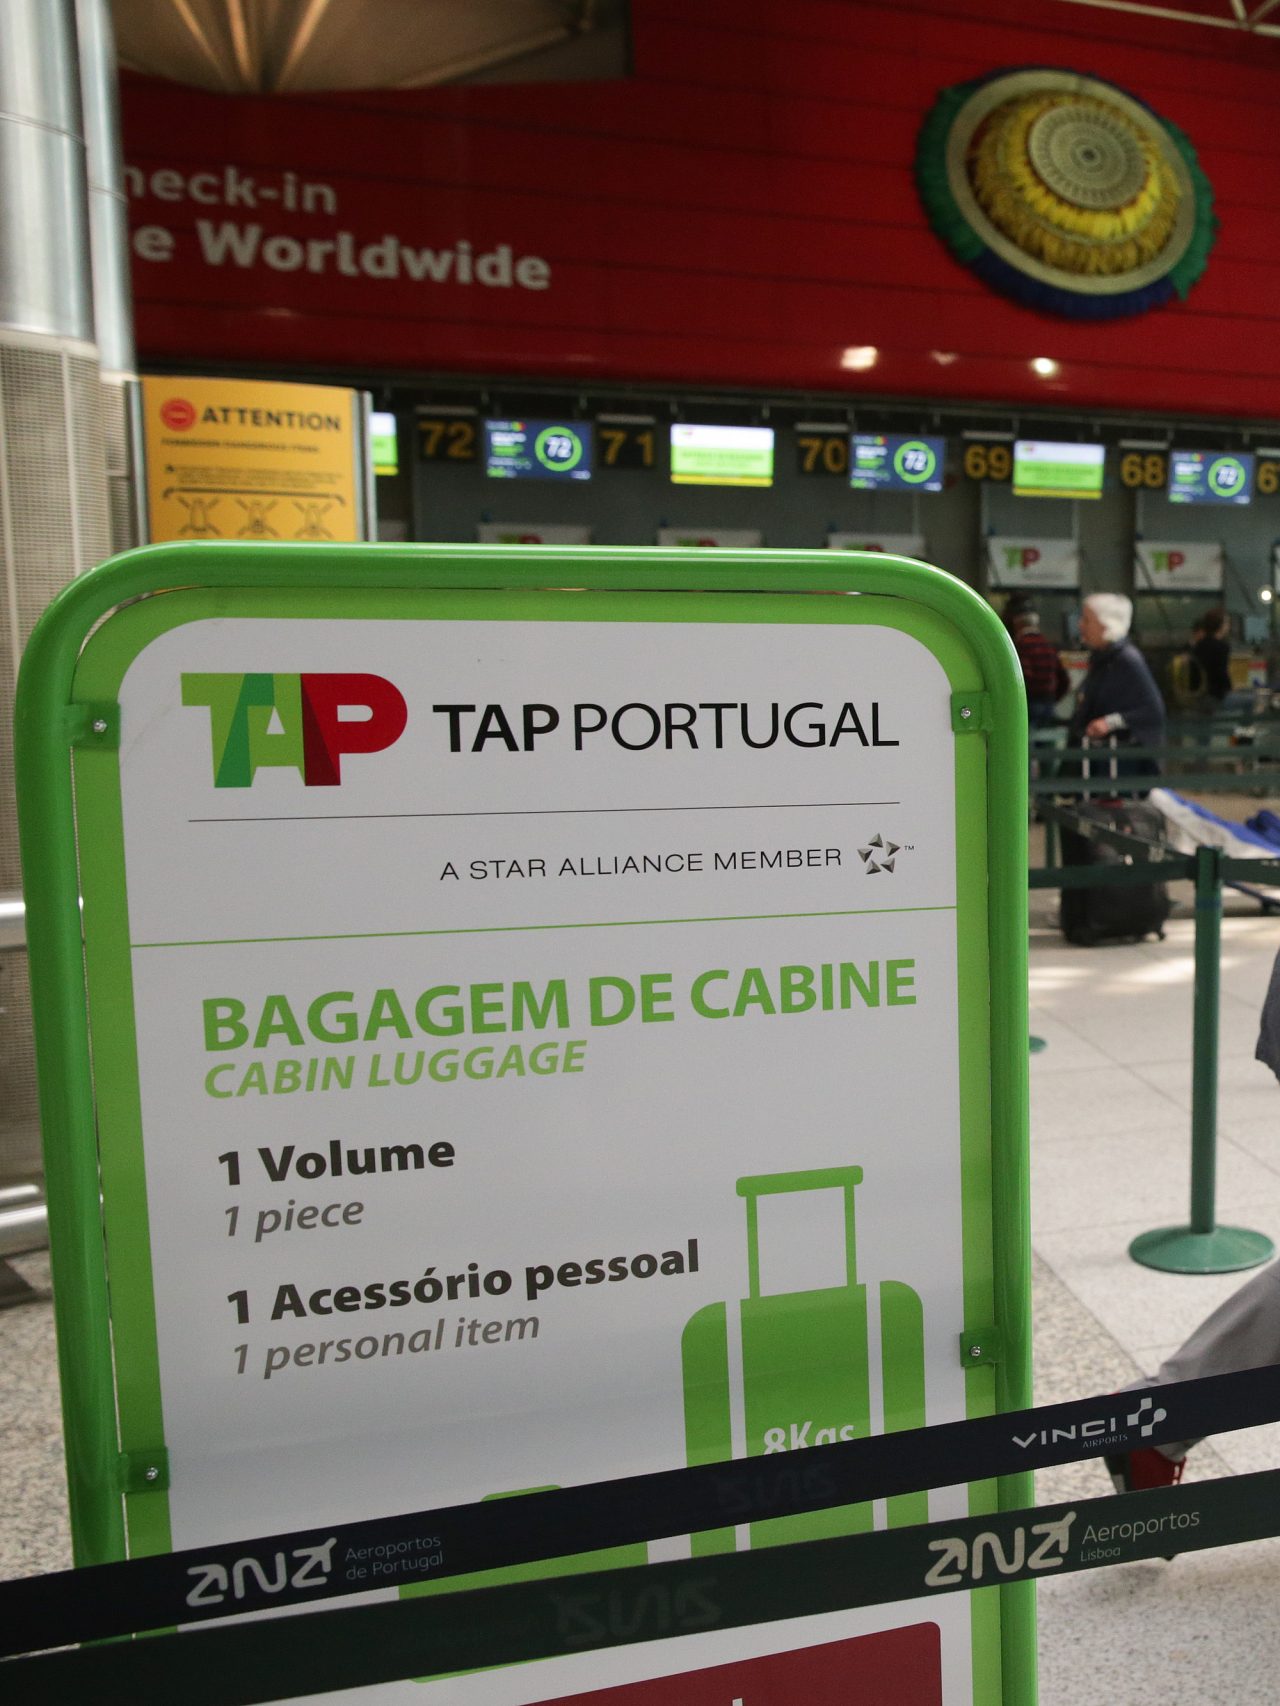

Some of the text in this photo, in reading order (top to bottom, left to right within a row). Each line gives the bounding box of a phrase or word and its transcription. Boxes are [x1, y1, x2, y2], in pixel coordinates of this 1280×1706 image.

[195, 219, 551, 291] Worldwide
[202, 405, 342, 432] ATTENTION
[419, 422, 475, 459] 72
[603, 430, 654, 465] 71
[799, 437, 847, 473] 70
[964, 445, 1012, 480] 69
[1121, 453, 1166, 488] 68
[181, 673, 408, 788] TAP
[433, 701, 900, 753] TAP PORTUGAL
[440, 861, 460, 881] A
[469, 858, 546, 881] STAR
[558, 852, 704, 878] ALLIANCE
[713, 847, 842, 872] MEMBER
[203, 958, 917, 1051] BAGAGEM DE CABINE
[204, 1040, 588, 1099] CABIN LUGGAGE
[218, 1139, 456, 1186] 1 Volume
[225, 1199, 364, 1243] 1 piece
[227, 1238, 700, 1324] 1 Acessório pessoal
[233, 1315, 540, 1379] 1 personal item
[1012, 1417, 1116, 1449] VINCI
[1082, 1433, 1129, 1449] AIRPORTS
[1081, 1511, 1201, 1544] Aeroportos
[345, 1536, 441, 1561] Aeroportos
[346, 1551, 444, 1581] de Portugal
[1080, 1546, 1121, 1562] Lisboa
